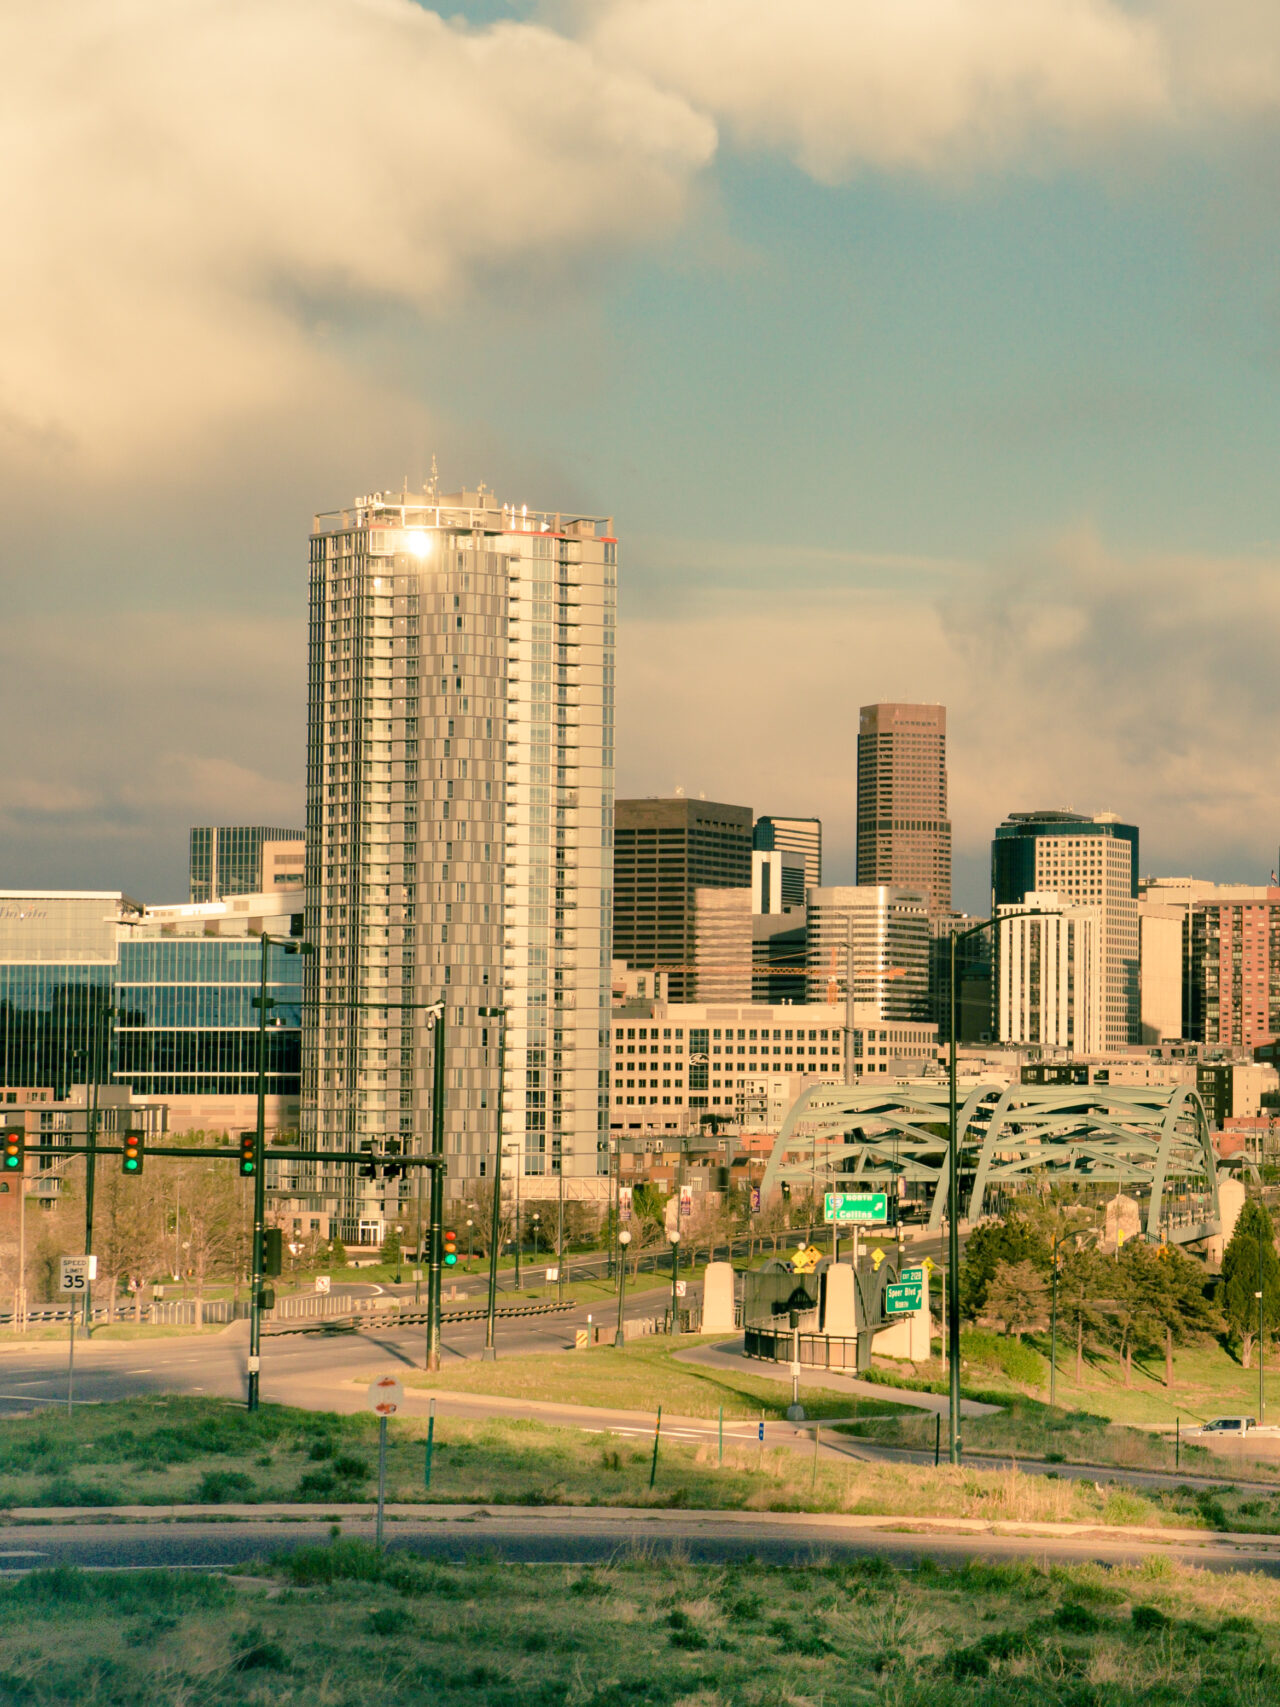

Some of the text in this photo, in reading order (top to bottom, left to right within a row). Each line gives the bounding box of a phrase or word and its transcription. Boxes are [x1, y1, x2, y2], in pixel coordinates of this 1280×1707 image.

[839, 1210, 873, 1218] Collins
[63, 1274, 85, 1288] 35
[888, 1287, 917, 1298] Speer Blvd
